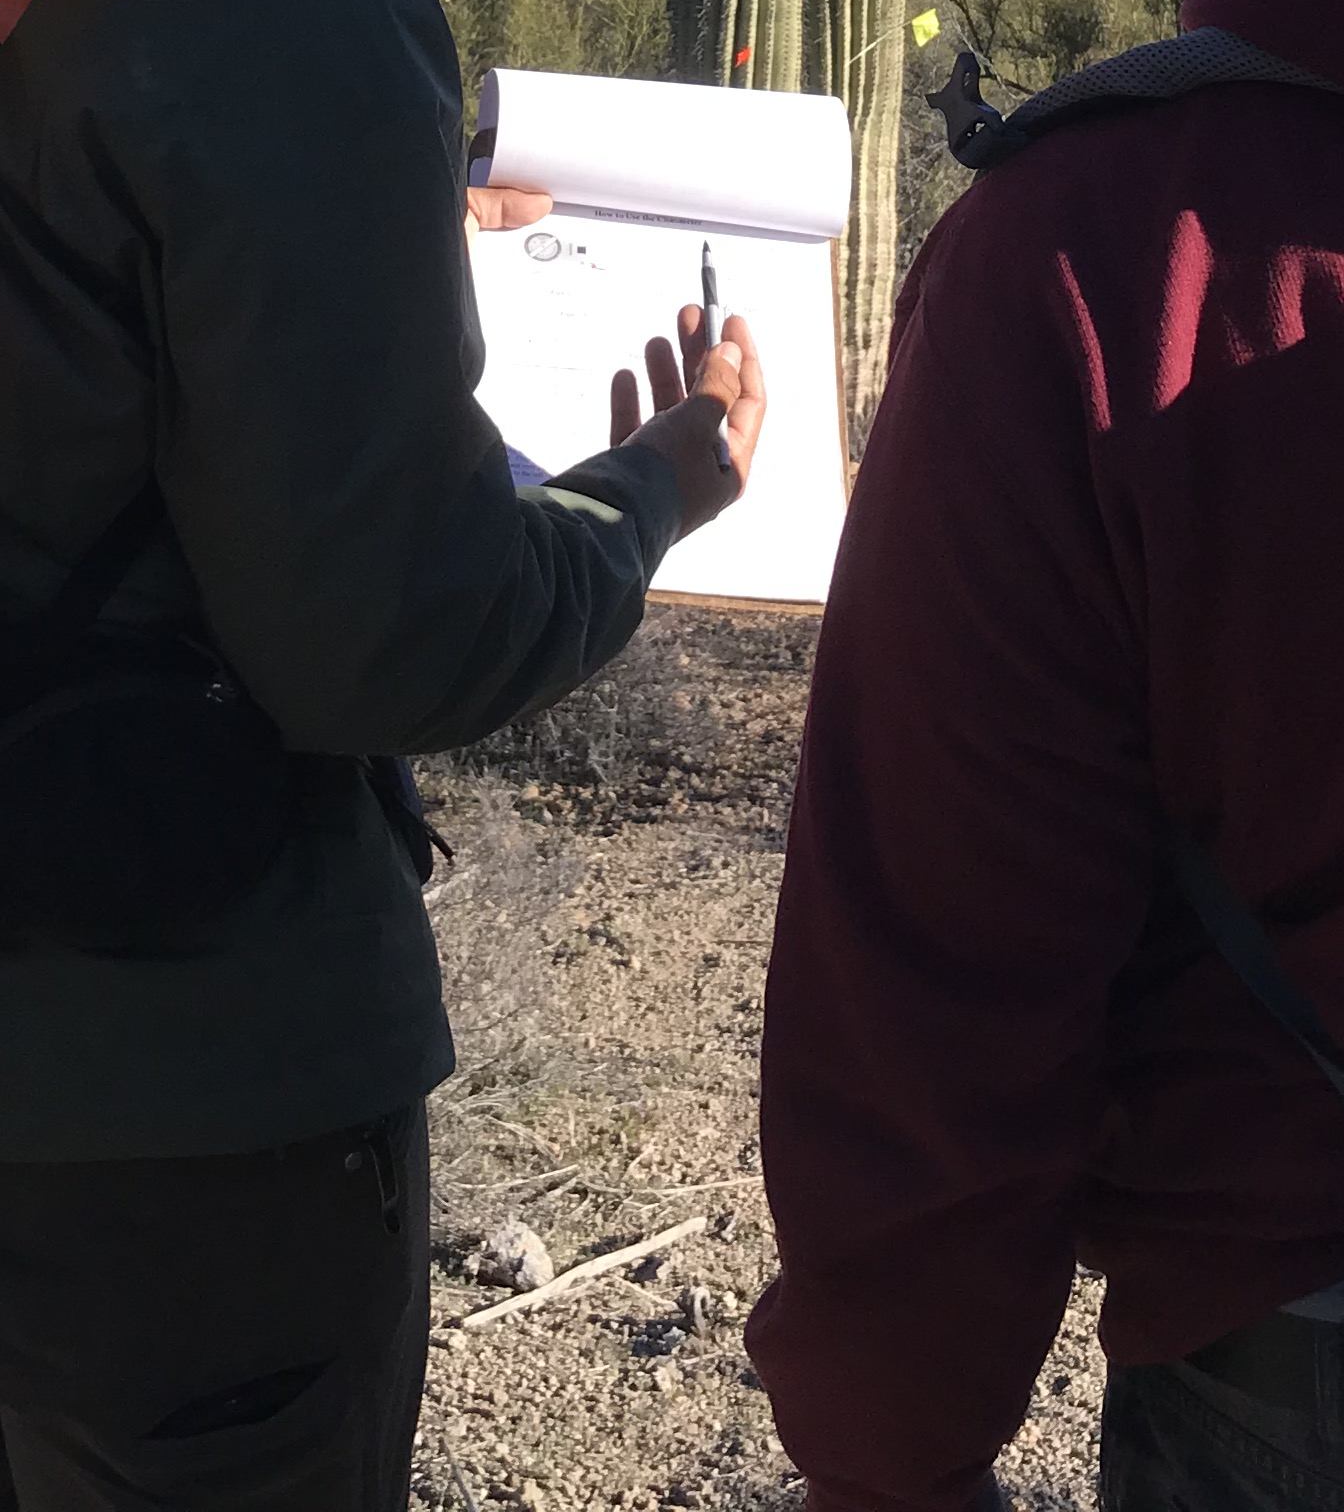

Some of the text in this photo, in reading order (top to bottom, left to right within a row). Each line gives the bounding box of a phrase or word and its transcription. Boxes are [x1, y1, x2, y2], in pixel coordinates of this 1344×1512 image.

[594, 210, 613, 218] How
[626, 212, 640, 221] Use
[642, 214, 654, 222] the
